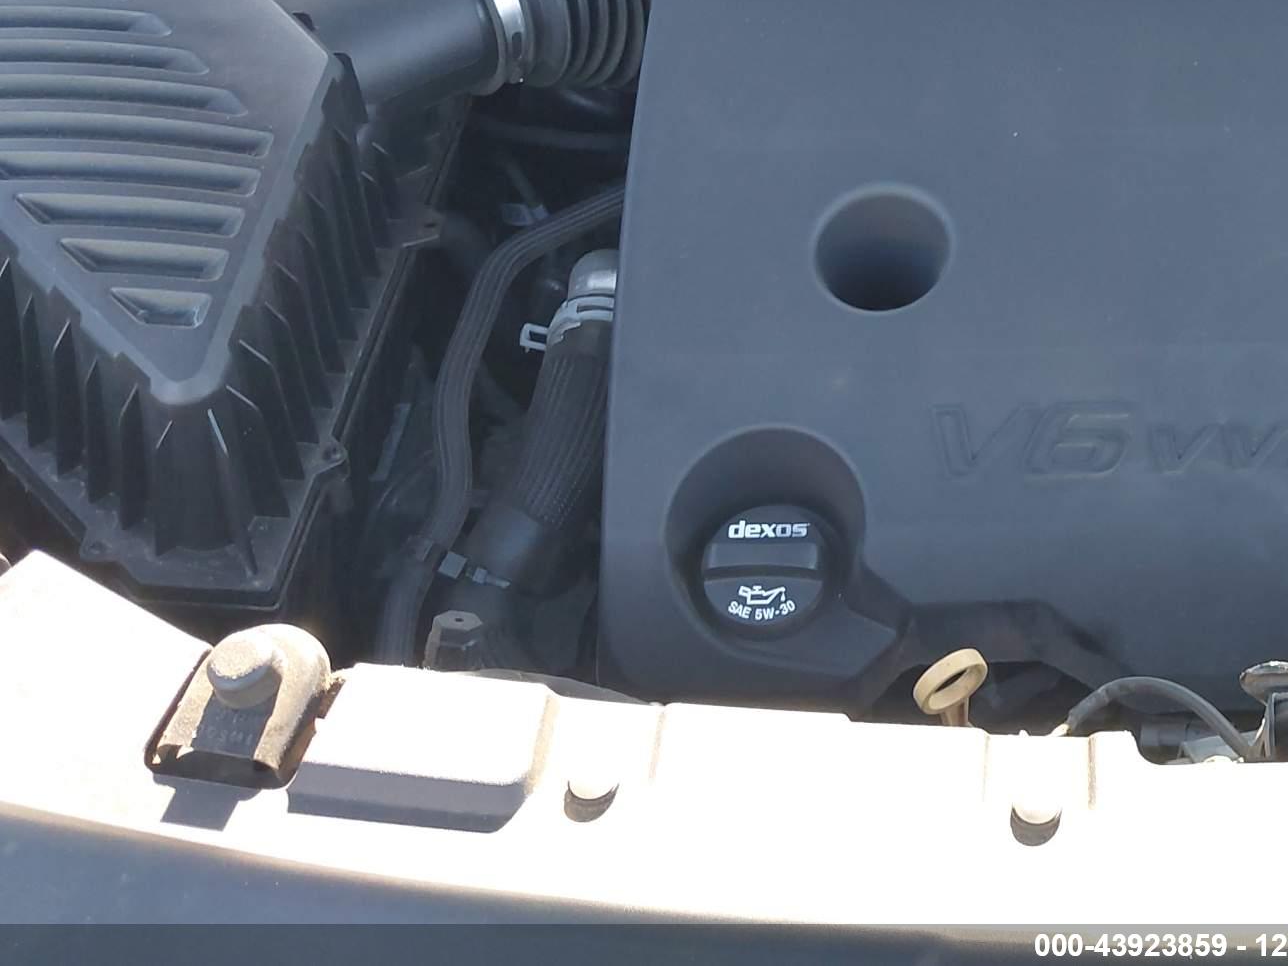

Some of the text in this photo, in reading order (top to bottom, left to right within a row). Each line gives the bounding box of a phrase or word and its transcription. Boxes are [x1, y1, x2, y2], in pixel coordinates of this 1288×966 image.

[930, 401, 1133, 480] V6
[728, 520, 808, 538] dexos
[728, 600, 796, 621] SAE 5W-30
